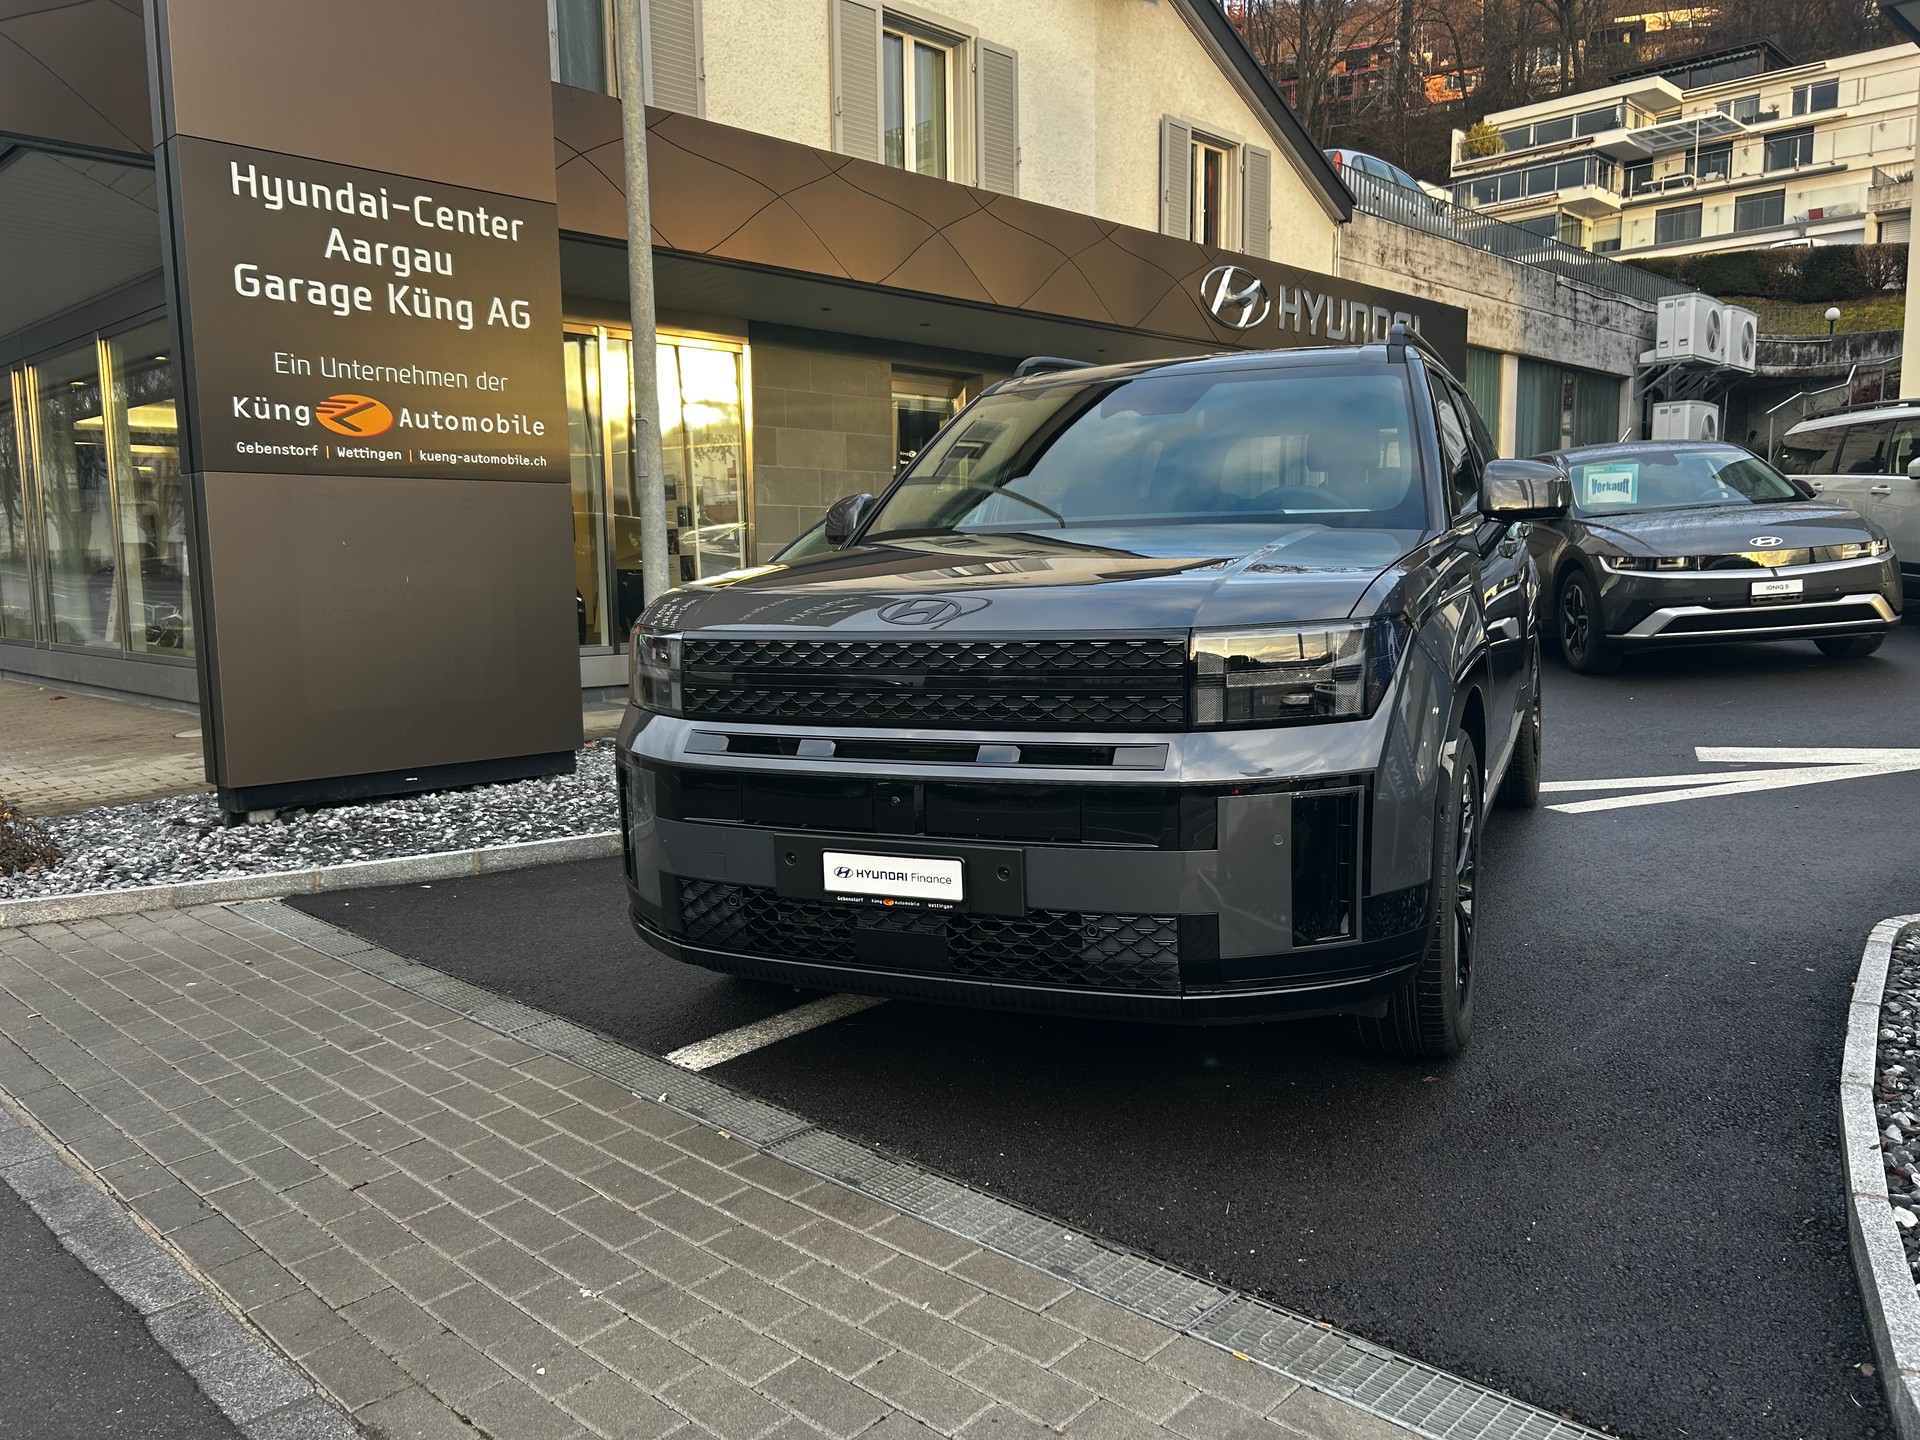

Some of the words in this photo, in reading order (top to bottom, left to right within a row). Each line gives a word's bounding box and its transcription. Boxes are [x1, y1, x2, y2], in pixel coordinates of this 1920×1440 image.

[230, 161, 524, 242] Hyundai-Center
[324, 227, 454, 278] Aargau
[233, 263, 372, 317] Garage
[387, 282, 474, 331] Küng
[487, 296, 531, 330] AG
[1278, 285, 1421, 345] HYUND
[274, 351, 311, 376] Ein
[320, 356, 468, 389] Unternehmen
[476, 371, 509, 392] der
[232, 396, 310, 427] Küng
[399, 407, 545, 436] Automobile
[236, 441, 319, 457] Gebenstorf
[336, 446, 402, 462] Wettingen
[419, 449, 547, 467] kueng-automobile.ch
[1591, 478, 1629, 495] Verkauft
[856, 869, 908, 882] HYUNDAI
[911, 873, 952, 885] Finance
